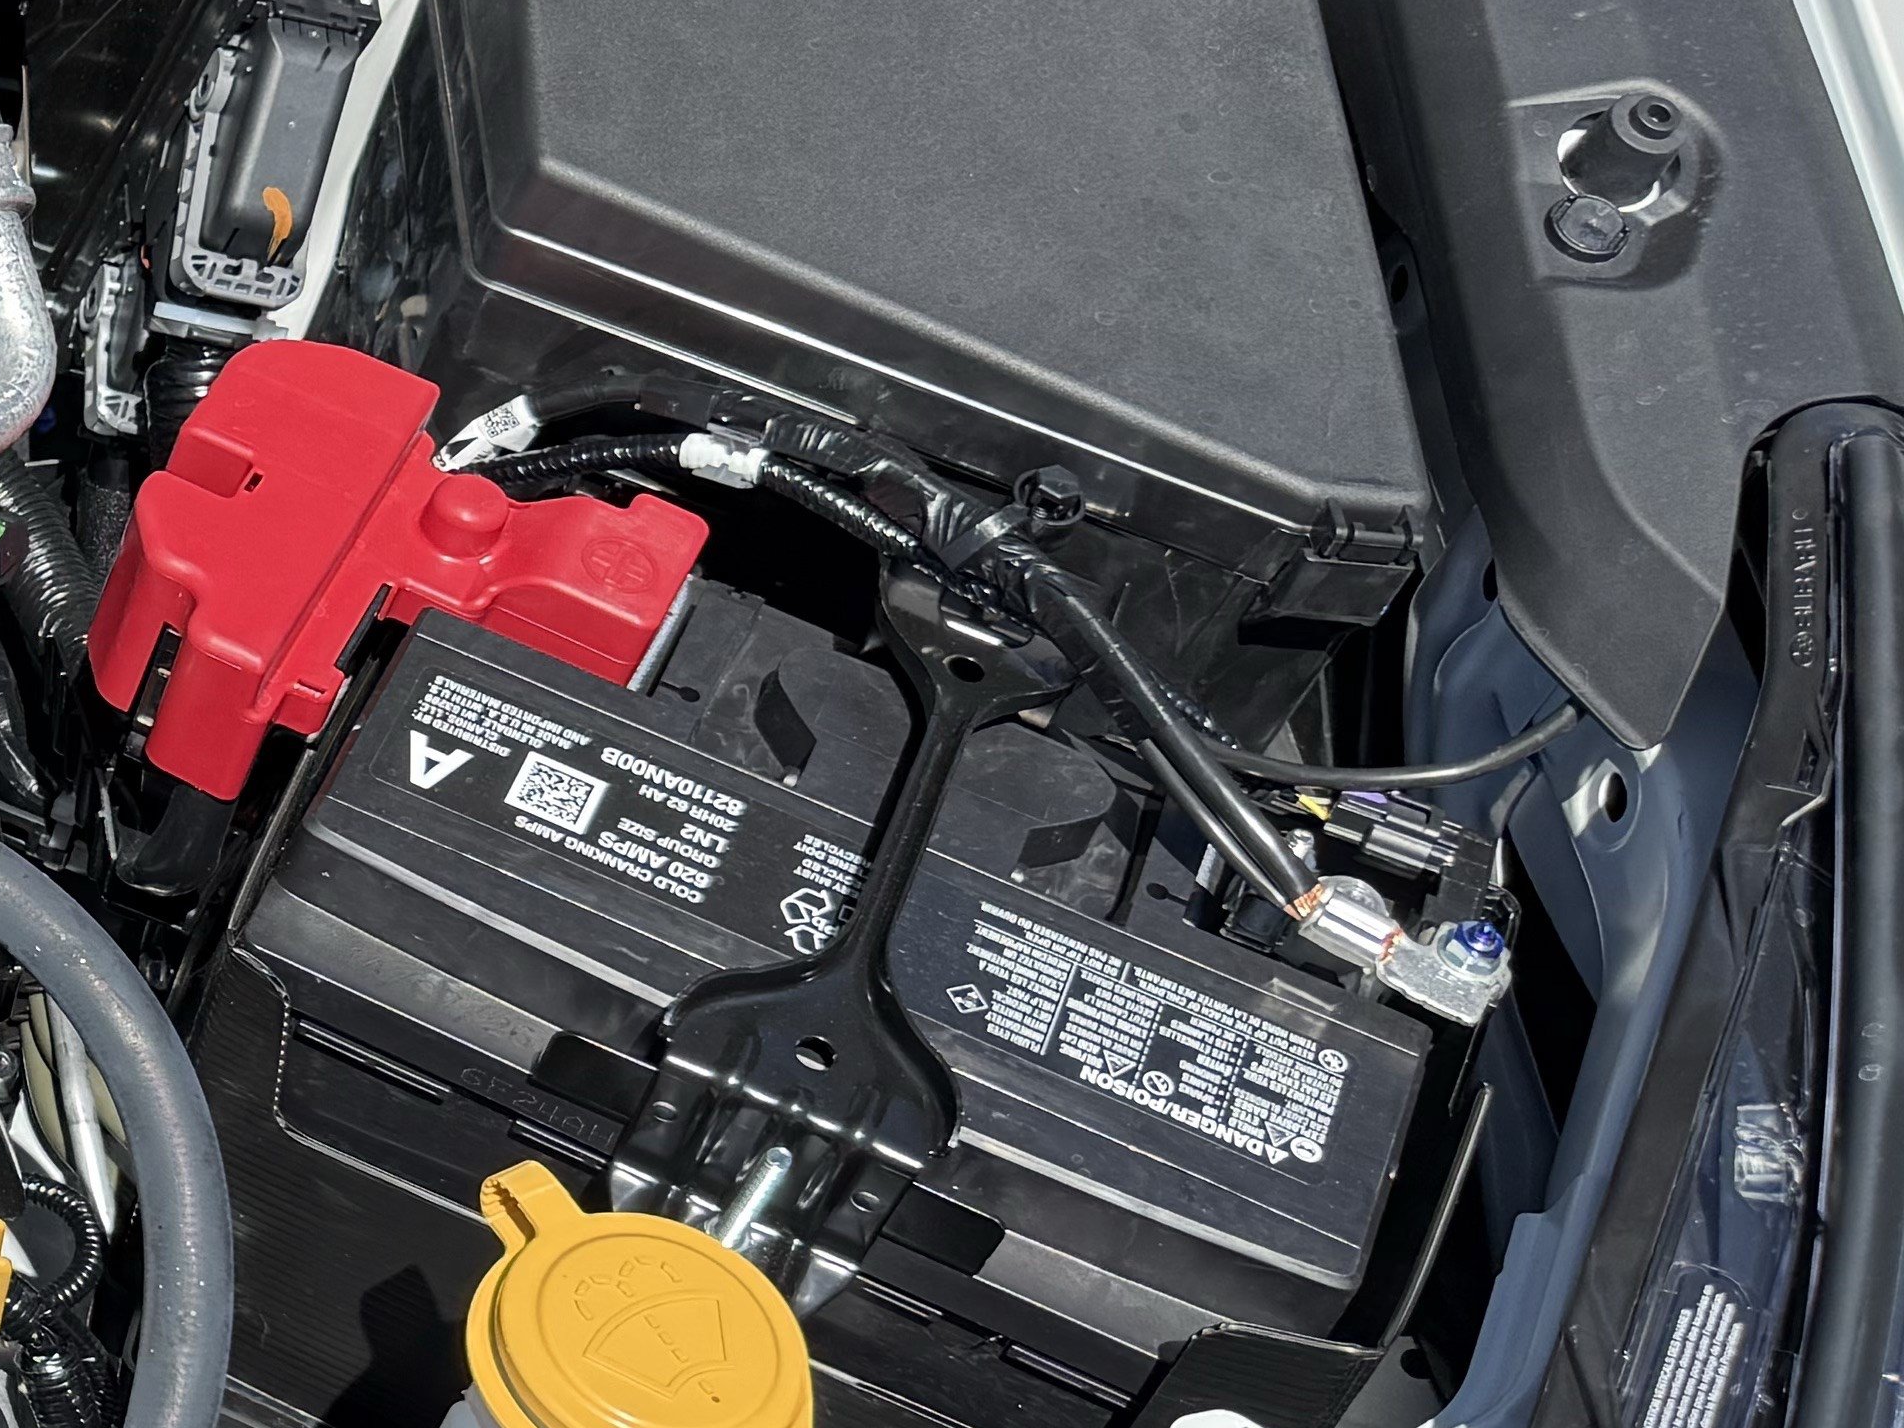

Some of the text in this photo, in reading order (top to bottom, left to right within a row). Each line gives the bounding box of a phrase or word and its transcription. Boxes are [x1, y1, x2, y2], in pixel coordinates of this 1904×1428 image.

[434, 676, 591, 745] AND IMPORTED MATERIALS
[451, 693, 483, 712] WITH
[432, 719, 511, 757] DISTRIBUTED
[521, 723, 536, 734] IN
[536, 729, 571, 749] MADE
[410, 730, 474, 789] A
[601, 747, 745, 816] 82110AN00B
[639, 784, 738, 832] 20HR 62 AH
[514, 816, 703, 903] COLD CRANKING AMPS
[598, 831, 711, 888] 620 AMPS
[617, 818, 718, 868] GROUP SIZE
[680, 823, 729, 853] LN2
[811, 916, 836, 935] Pb
[1080, 1065, 1264, 1156] DANGER/POISON
